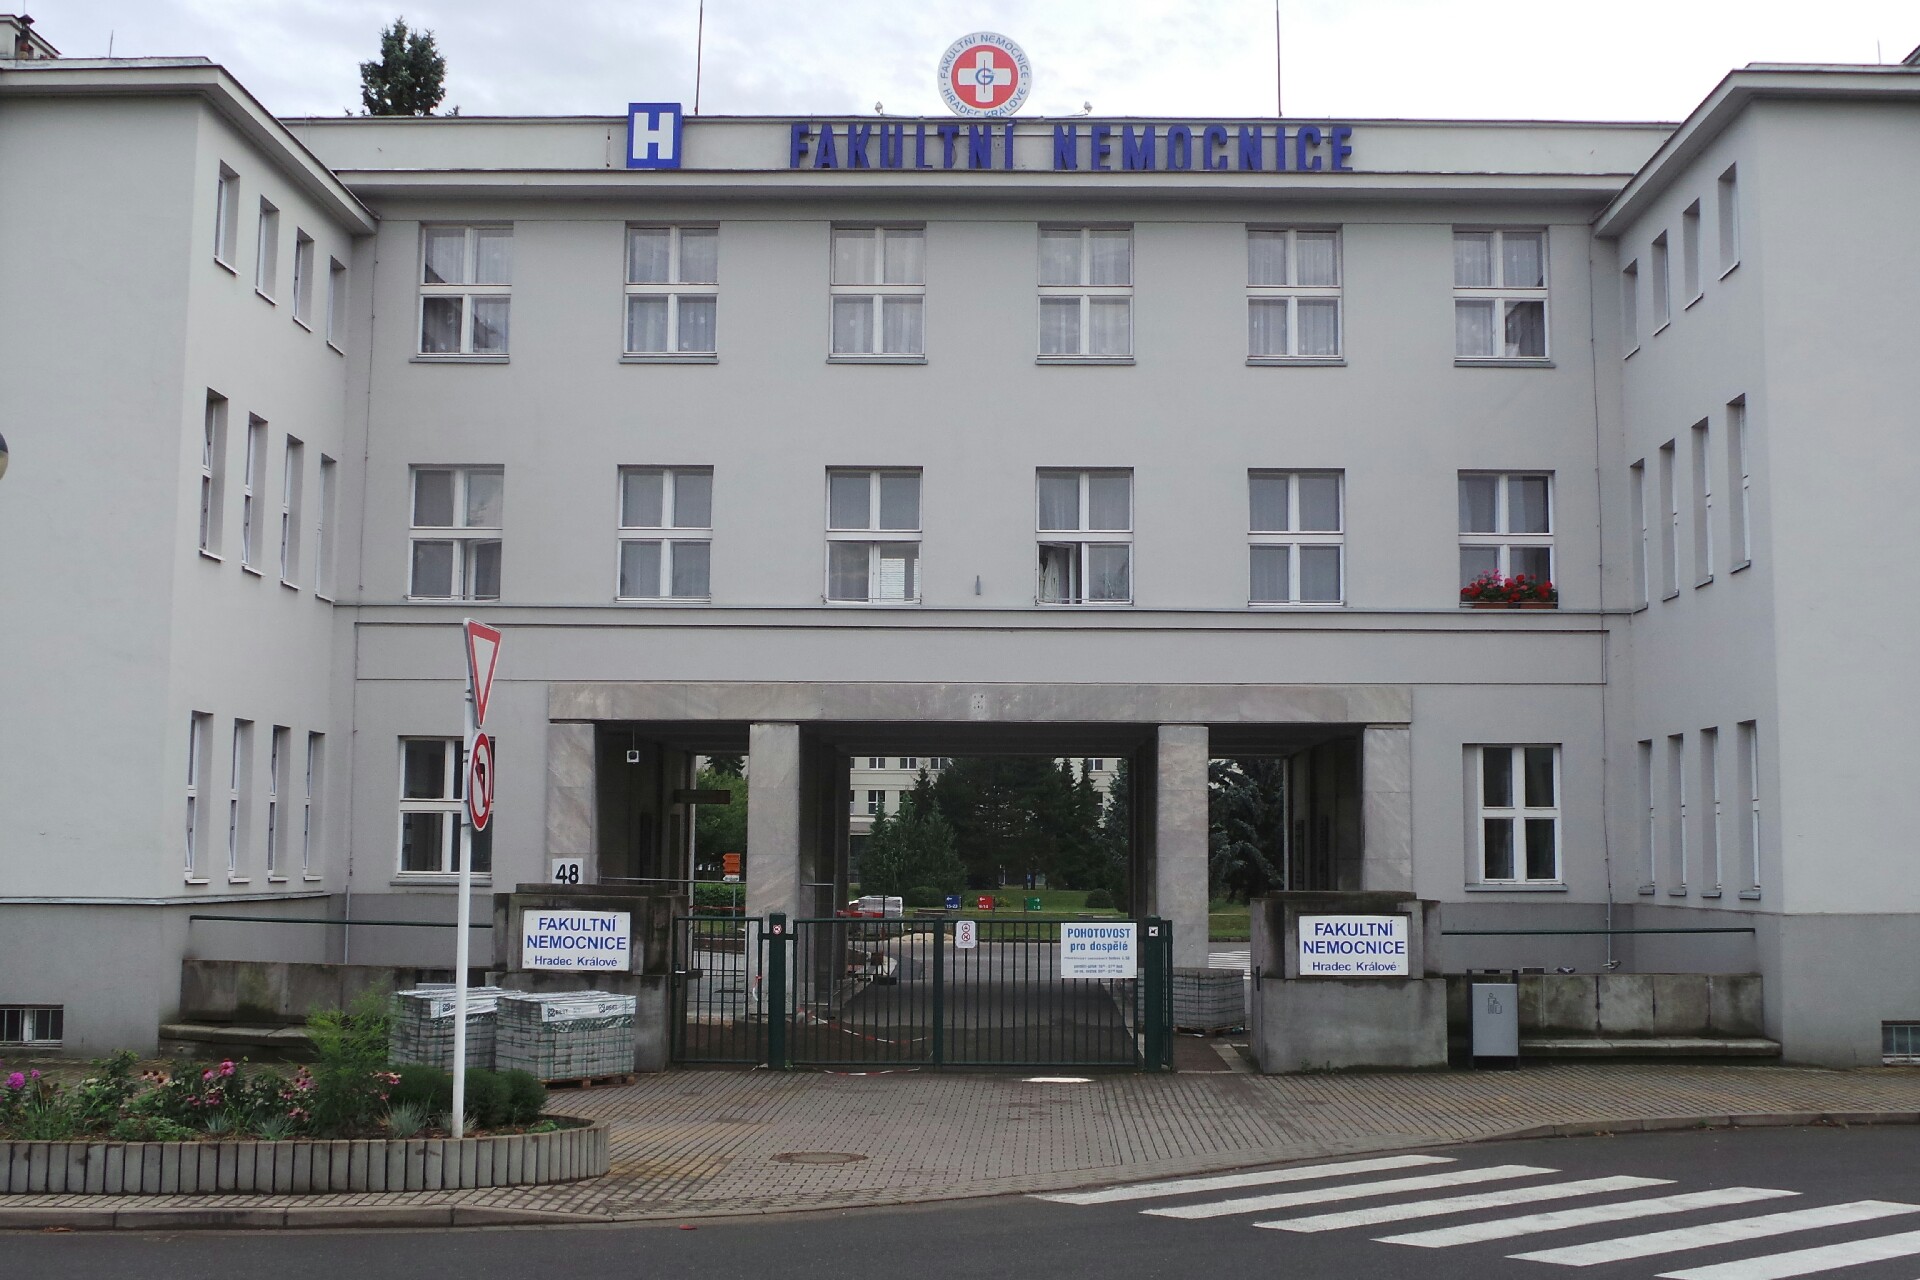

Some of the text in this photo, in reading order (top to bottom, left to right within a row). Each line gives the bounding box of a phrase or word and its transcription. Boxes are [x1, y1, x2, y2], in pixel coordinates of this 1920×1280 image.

[940, 34, 1030, 79] FAKULTNÍ NEMOCNICE
[632, 112, 675, 160] H
[790, 120, 1353, 171] FAKULTNÍ NEMOCNICE
[555, 864, 579, 884] 48
[538, 915, 617, 932] FAKULTNÍ
[1314, 920, 1393, 936] FAKULTNÍ
[1067, 928, 1131, 938] POHOTOVOST
[527, 935, 626, 950] NEMOCNICE
[1070, 941, 1128, 953] pro dospělé
[1303, 941, 1405, 954] NEMOCNICE
[534, 955, 617, 966] Hradec Králové
[1312, 961, 1397, 971] Hradec Králové
